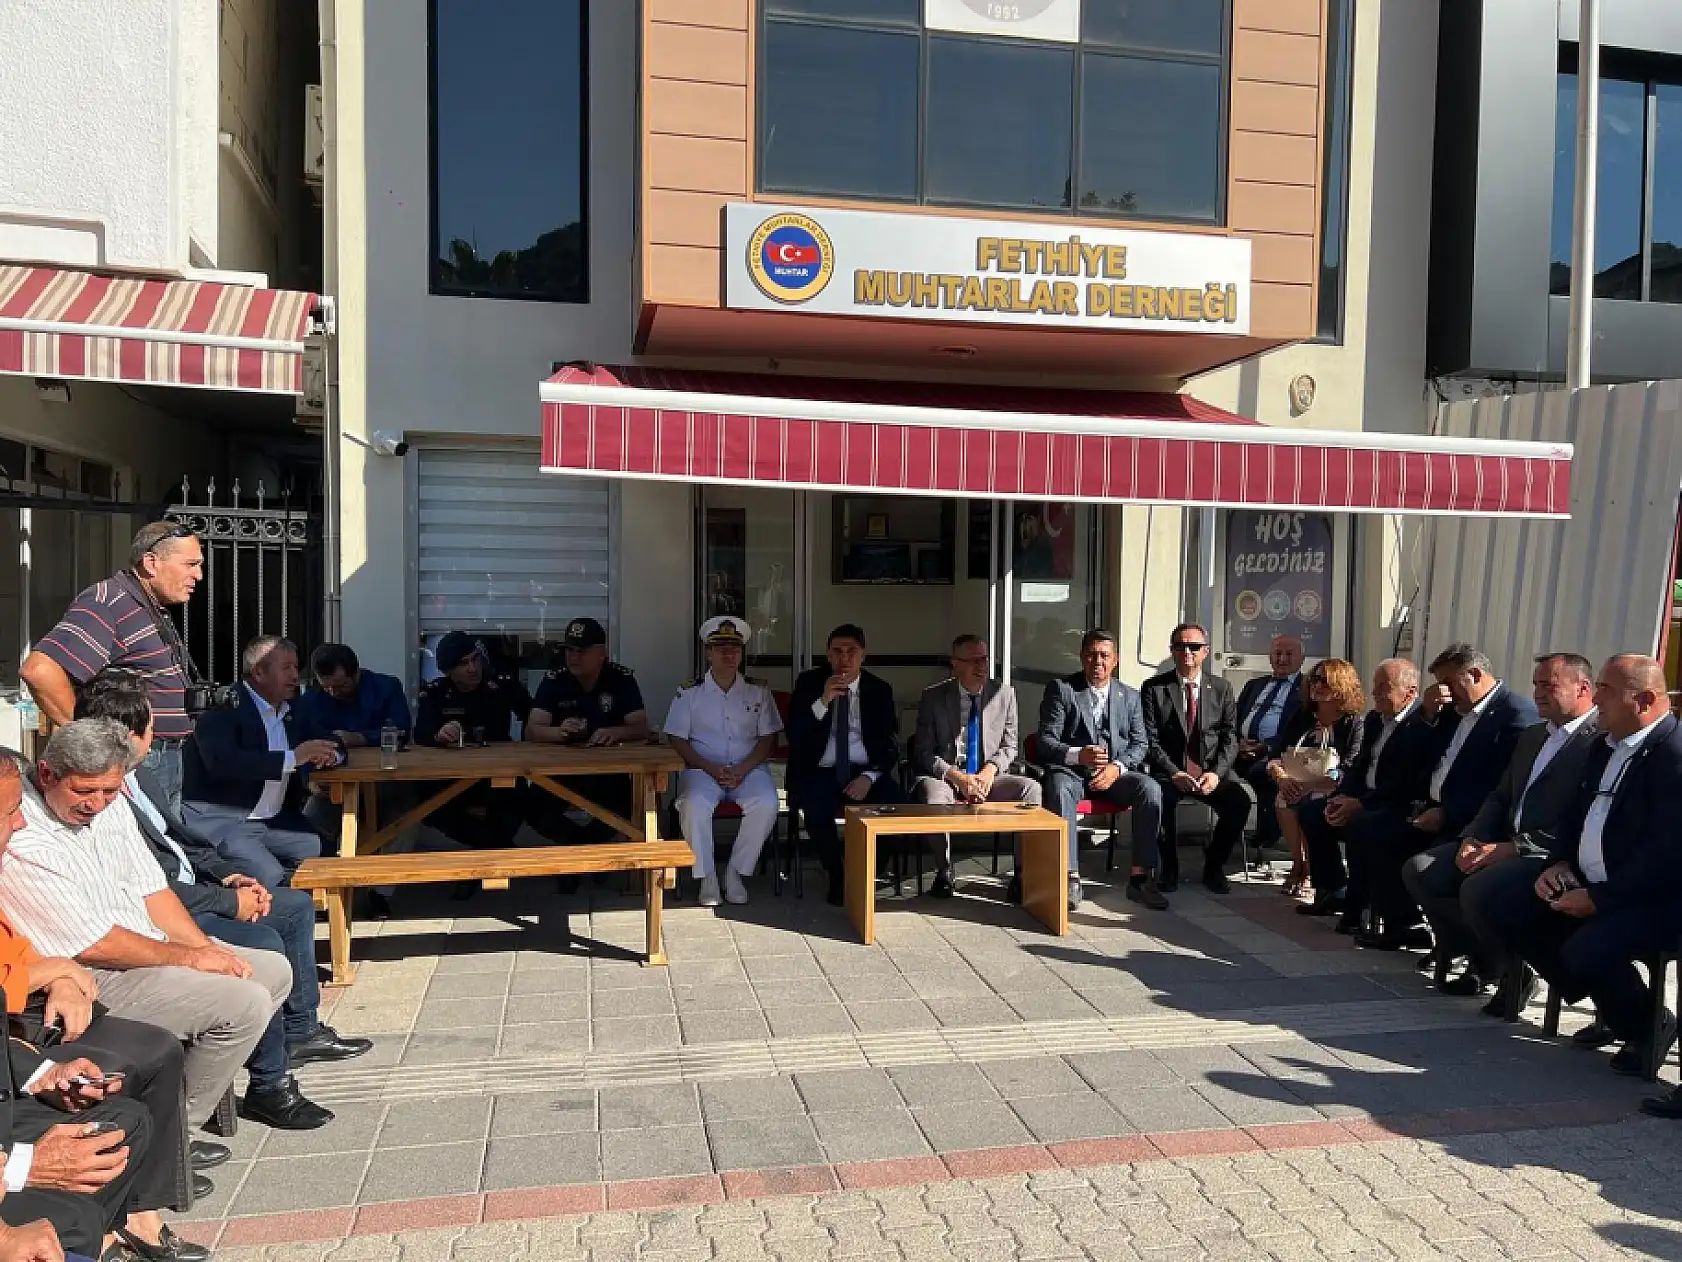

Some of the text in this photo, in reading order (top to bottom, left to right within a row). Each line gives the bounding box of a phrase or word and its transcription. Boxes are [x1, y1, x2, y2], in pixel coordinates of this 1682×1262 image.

[774, 266, 809, 277] MUHTAR
[976, 235, 1127, 280] FETHİYE
[854, 268, 1238, 323] MUHTARLAR DERNEĞİ
[1255, 512, 1306, 547] HOŞ
[1235, 547, 1326, 577] GELDİNİZ
